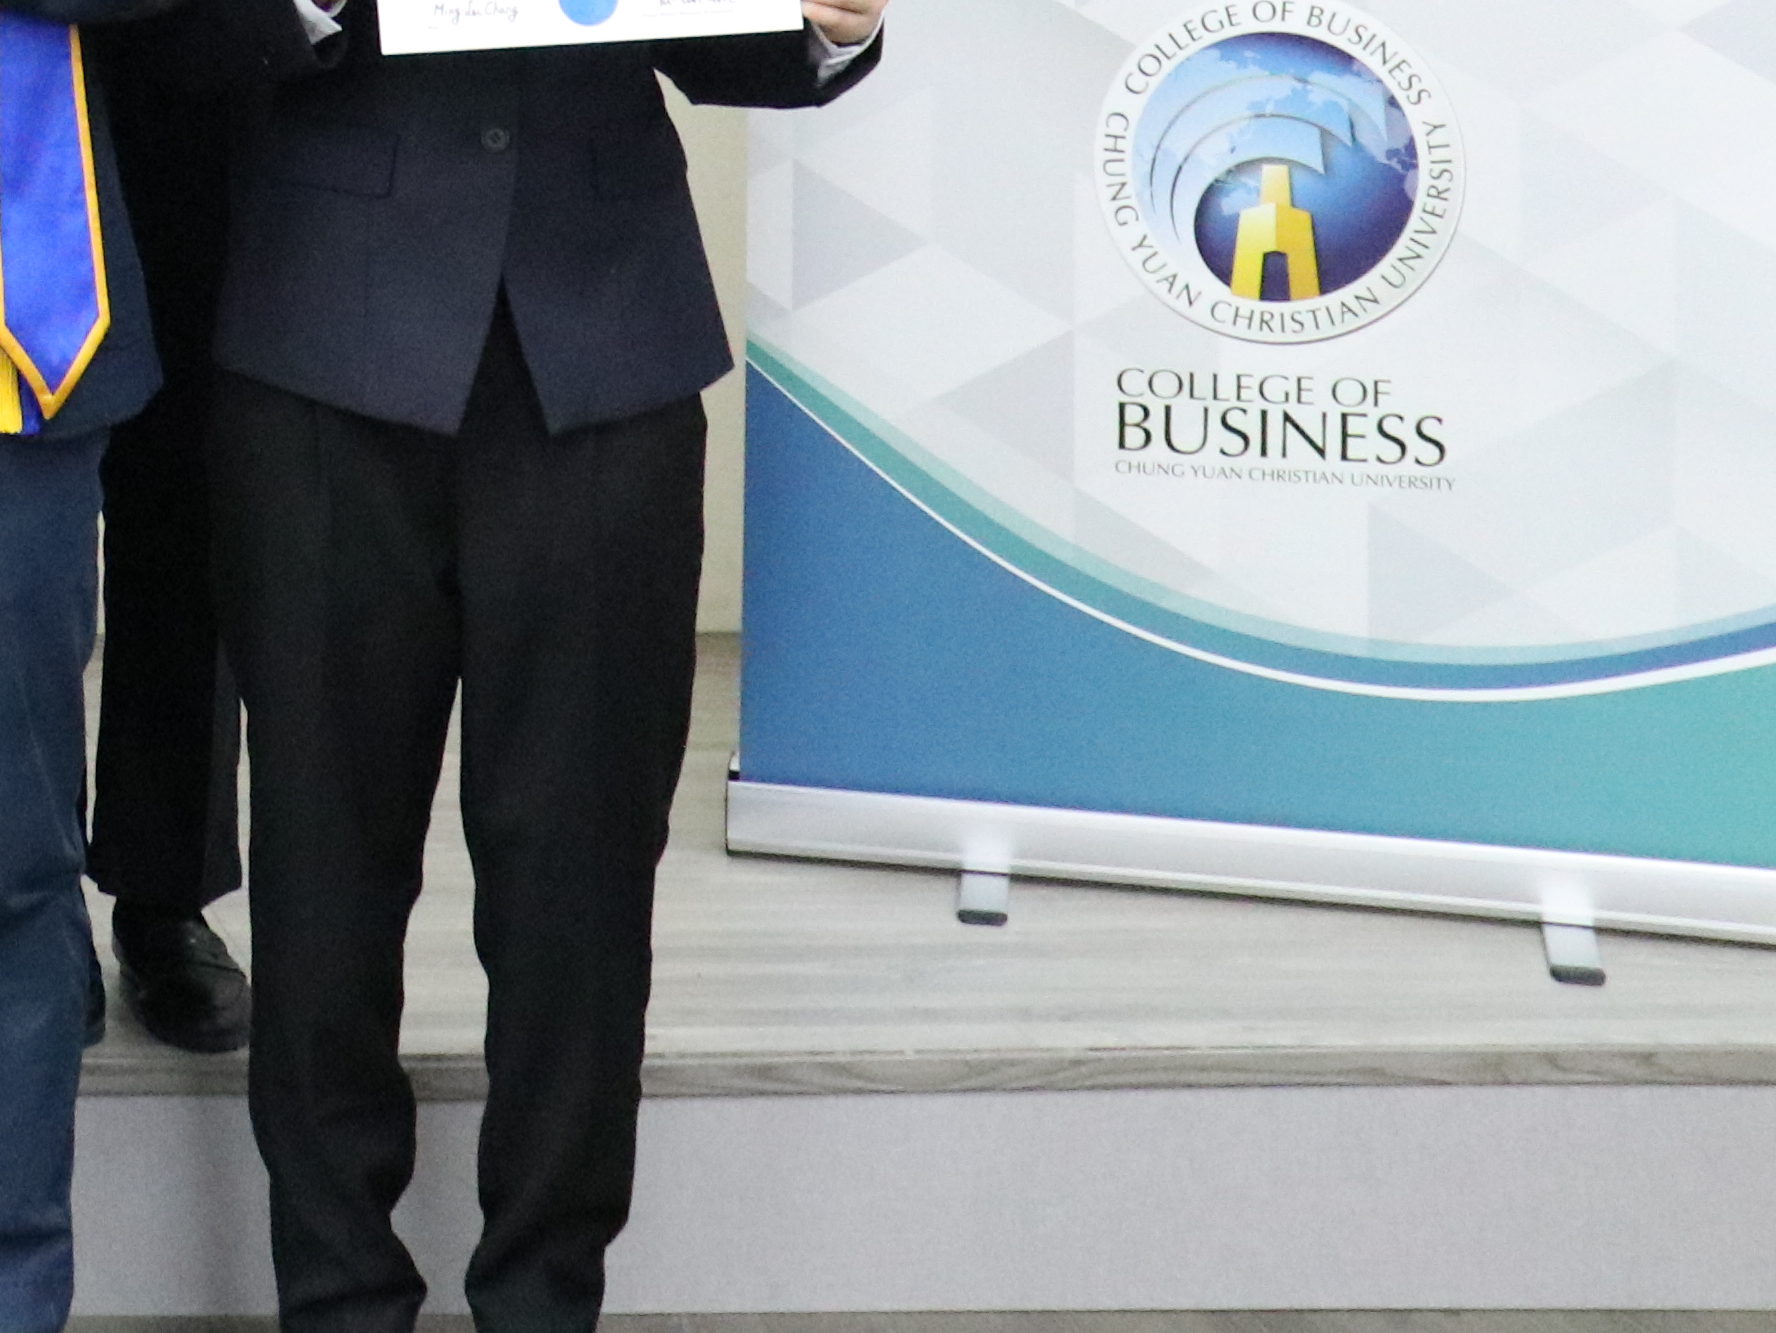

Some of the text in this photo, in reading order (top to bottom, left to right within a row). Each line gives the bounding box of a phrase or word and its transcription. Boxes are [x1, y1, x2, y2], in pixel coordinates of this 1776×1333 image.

[1124, 0, 1433, 107] COLLEGE OF BUSINESS
[1102, 111, 1454, 335] CHUNG YUAN CHRISTIAN UNIVERSITY
[1116, 367, 1393, 408] COLLEGE OF
[1117, 401, 1447, 467] BUSINESS
[1114, 459, 1457, 491] CHUNG YUAN CHRISTIAN UNIVERSITY
